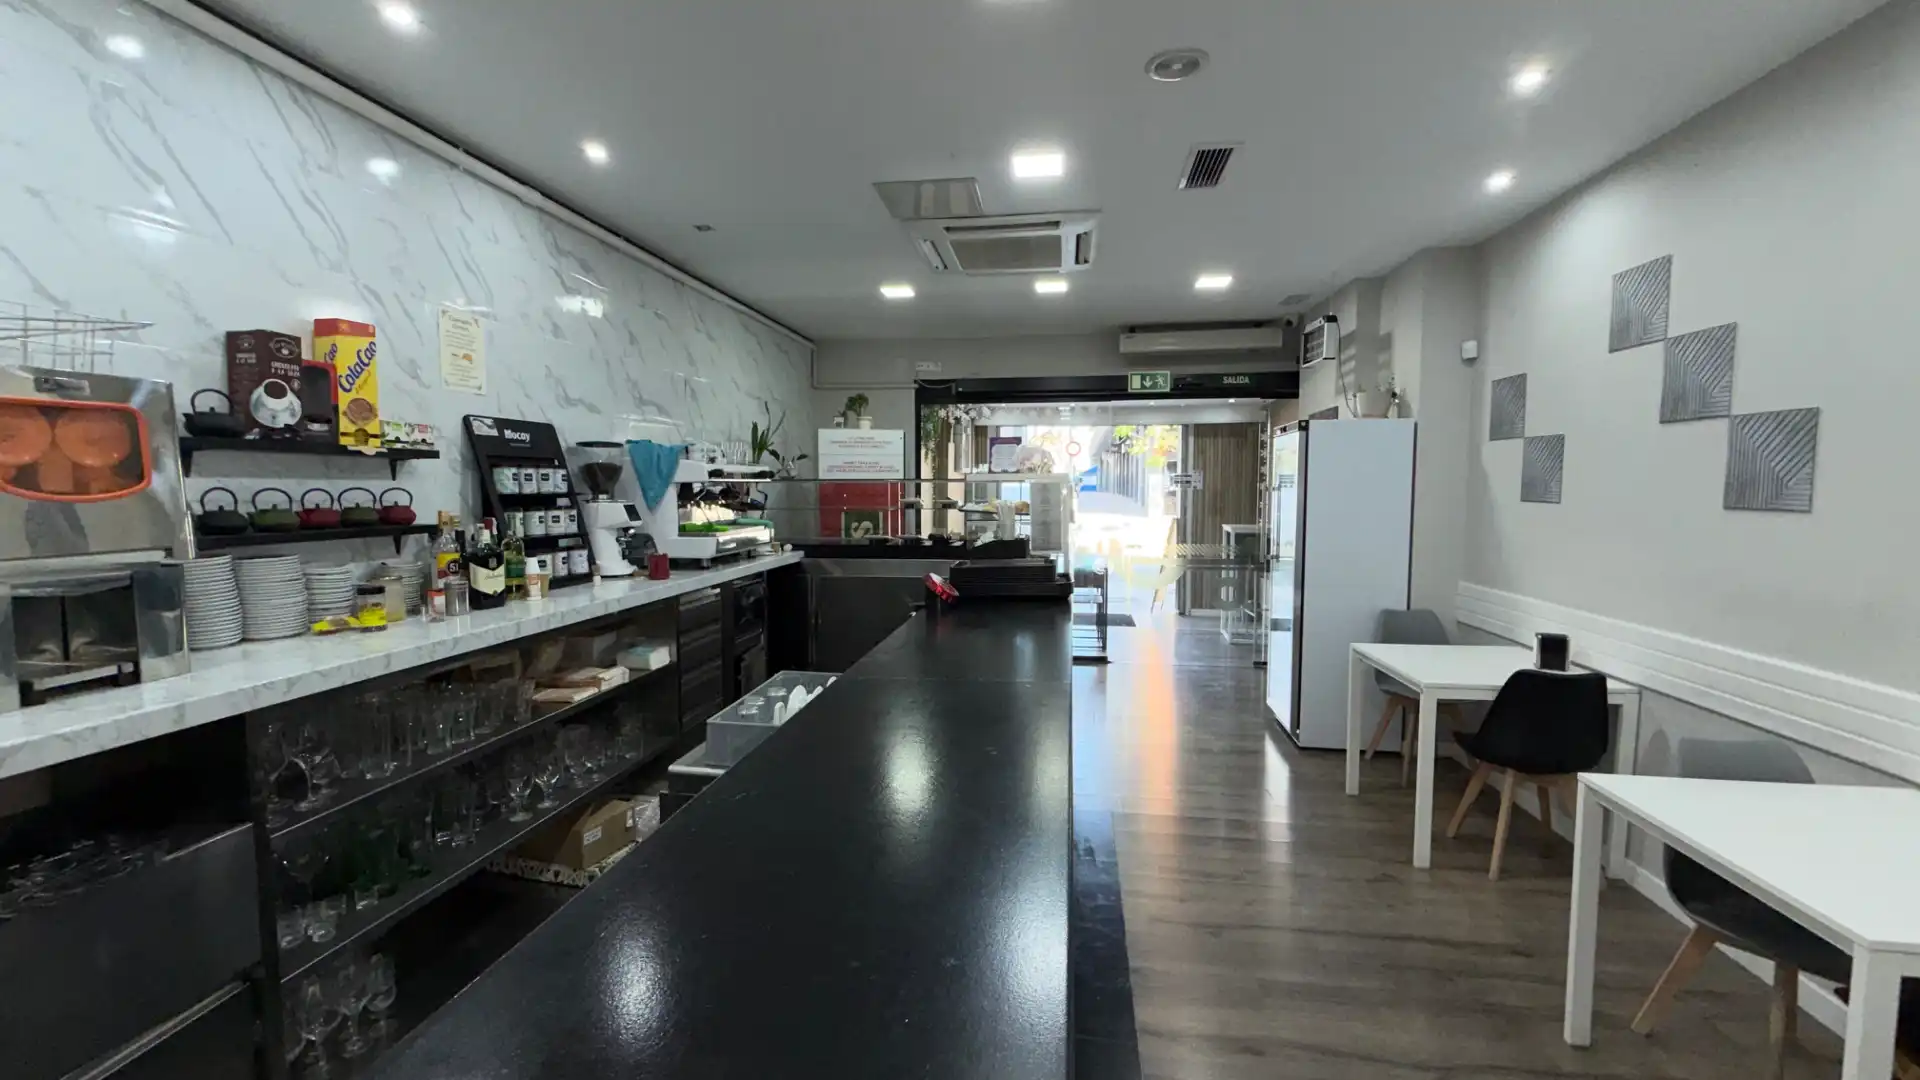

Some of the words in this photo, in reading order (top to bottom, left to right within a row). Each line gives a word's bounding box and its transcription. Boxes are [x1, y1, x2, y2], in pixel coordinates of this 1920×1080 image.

[338, 341, 377, 393] ColaCao
[1222, 375, 1250, 384] SALIDA
[504, 429, 531, 443] Mocay
